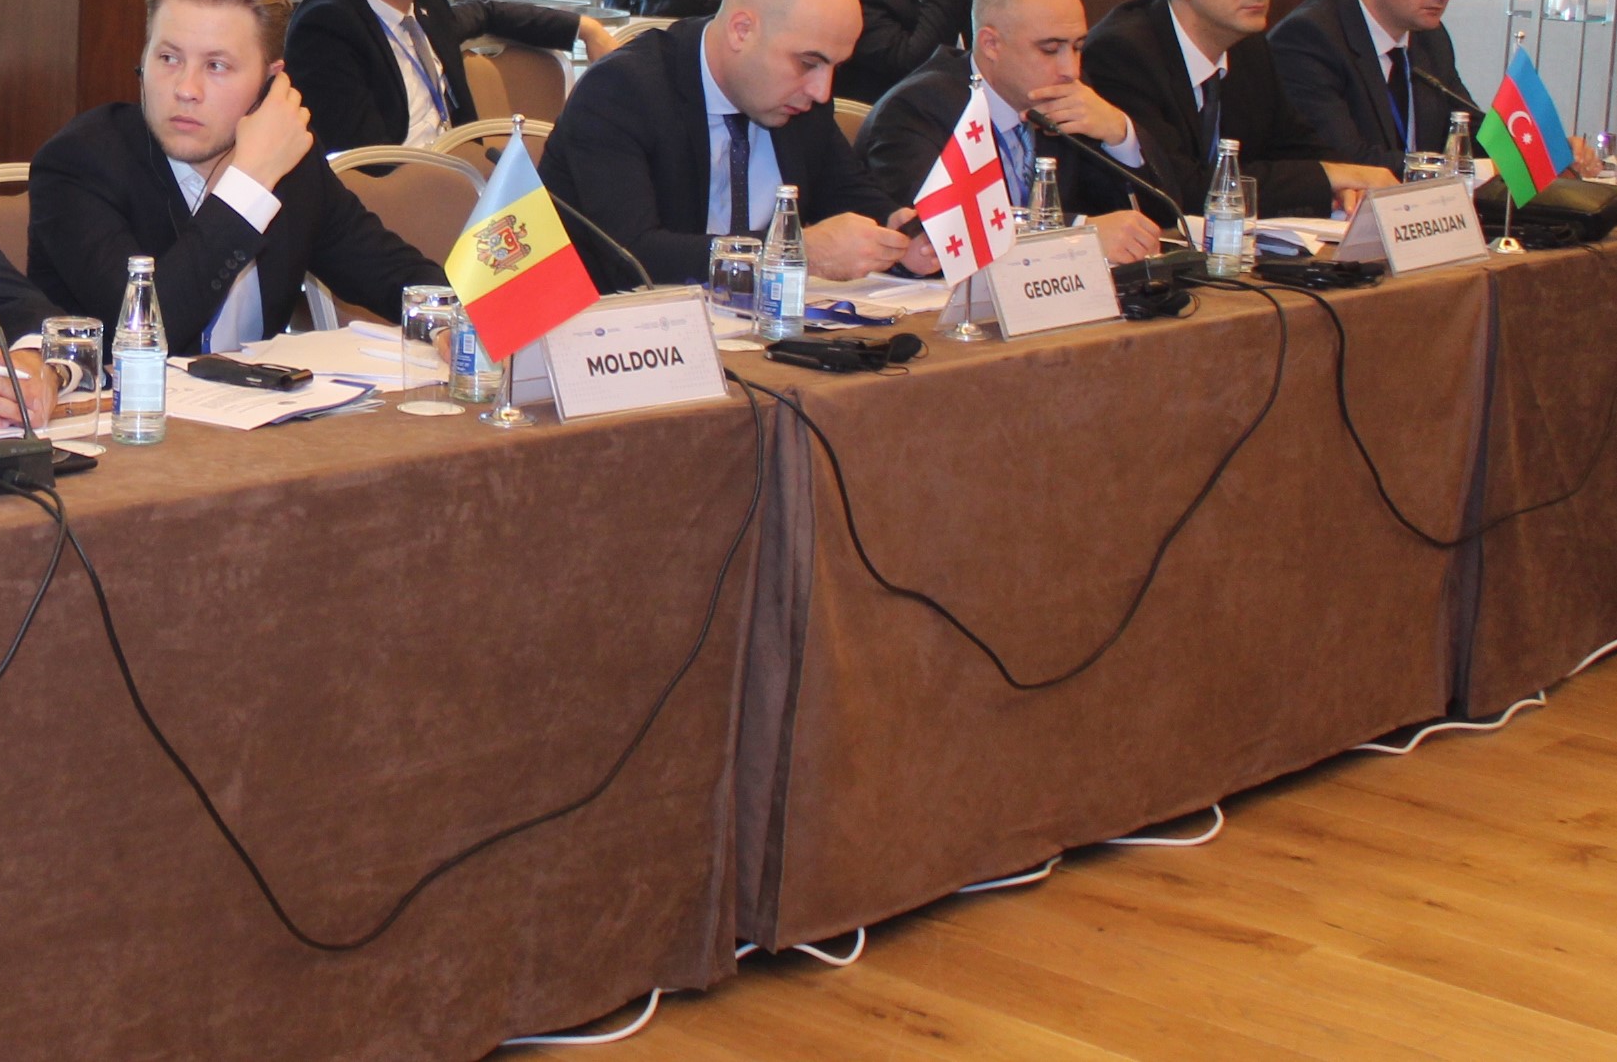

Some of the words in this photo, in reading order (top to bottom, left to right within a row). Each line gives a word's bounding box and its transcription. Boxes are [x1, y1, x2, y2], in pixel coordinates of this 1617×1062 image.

[1394, 214, 1467, 242] AZERBAIJAN
[1024, 274, 1085, 299] GEORGIA
[586, 346, 684, 376] MOLDOVA
